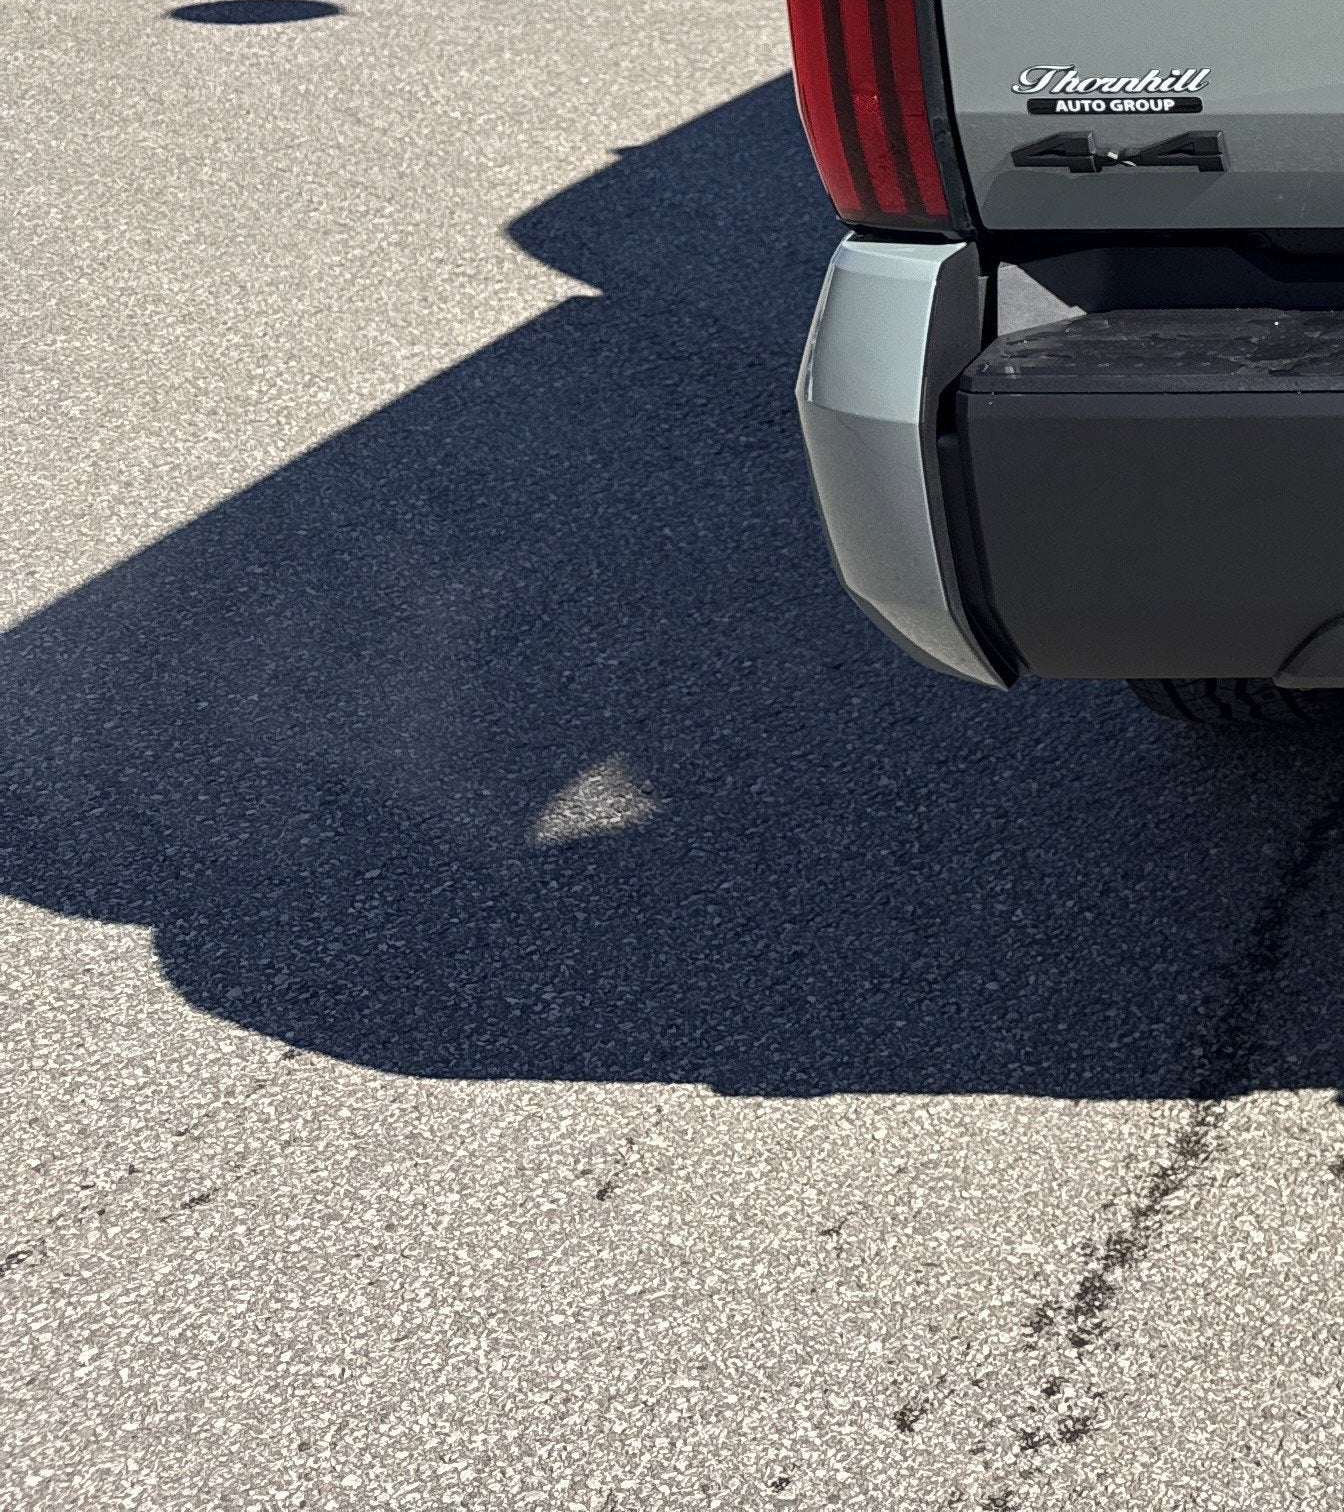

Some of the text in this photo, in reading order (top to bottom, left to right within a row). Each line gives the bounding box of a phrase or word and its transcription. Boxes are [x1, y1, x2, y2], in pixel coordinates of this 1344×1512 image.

[1011, 64, 1212, 95] Thornhill
[1055, 98, 1176, 113] AUTO GROUP
